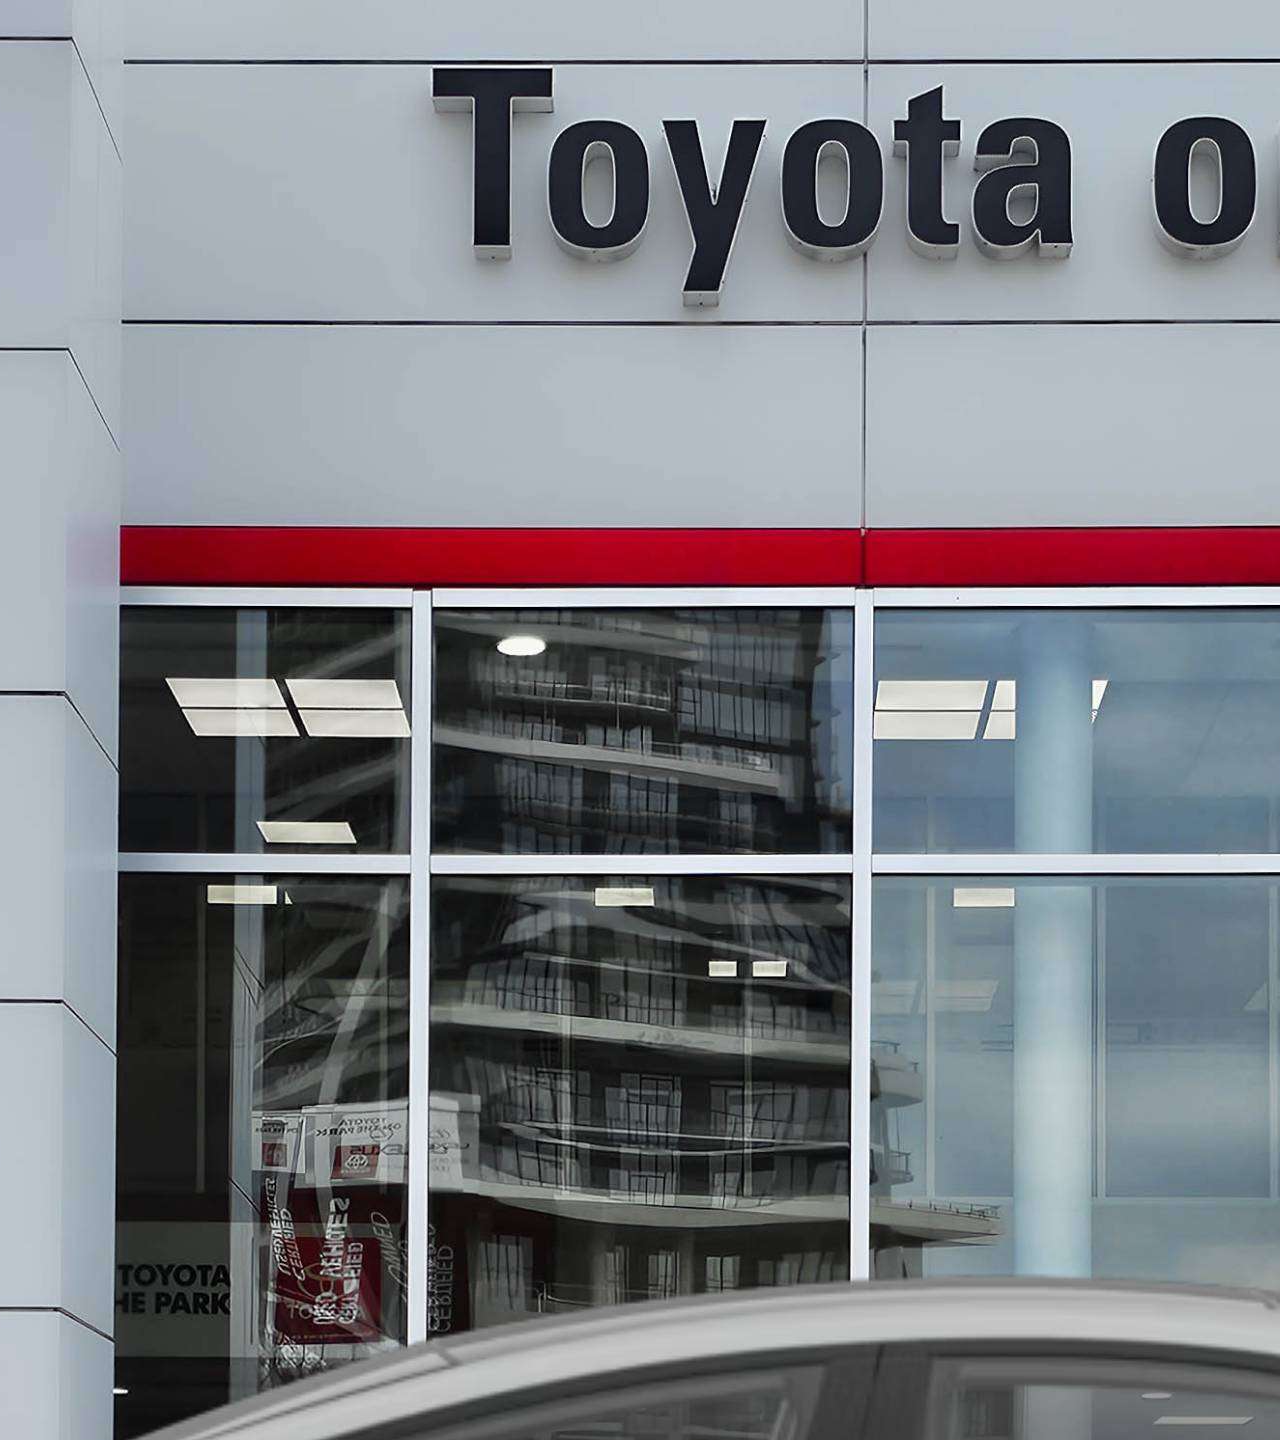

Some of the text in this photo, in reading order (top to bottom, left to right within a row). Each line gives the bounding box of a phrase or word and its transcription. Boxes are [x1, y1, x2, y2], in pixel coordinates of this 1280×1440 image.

[431, 67, 1075, 295] Toyota
[117, 1264, 231, 1287] TOYOTA
[116, 1291, 231, 1315] HE PARK
